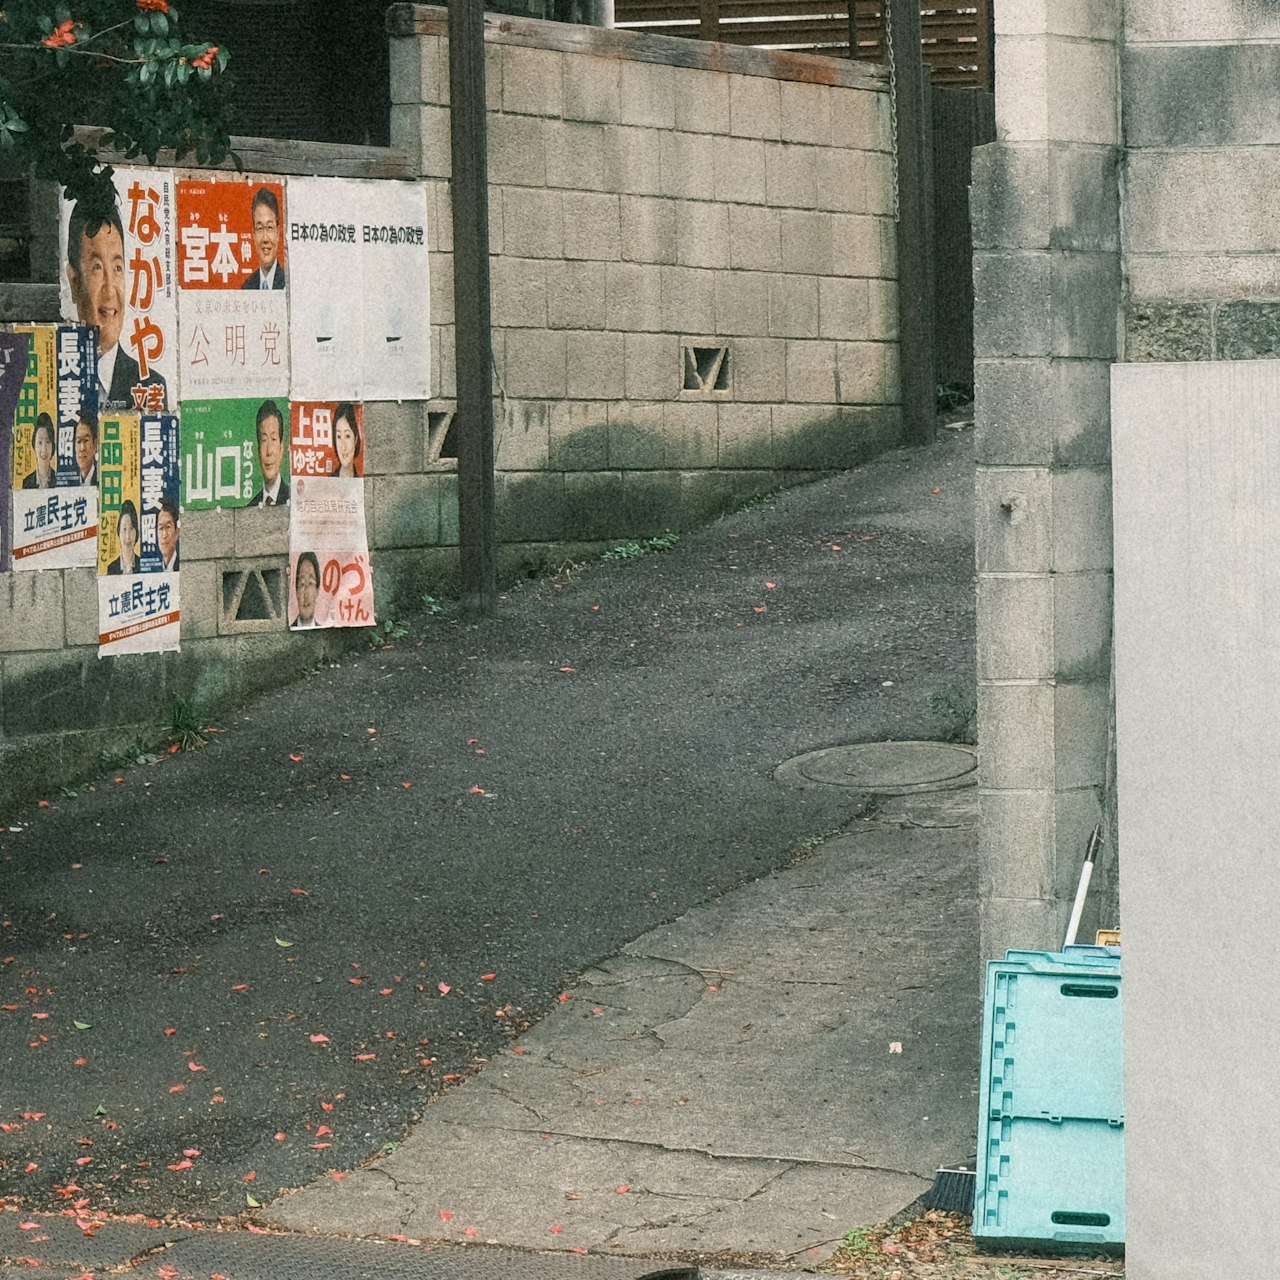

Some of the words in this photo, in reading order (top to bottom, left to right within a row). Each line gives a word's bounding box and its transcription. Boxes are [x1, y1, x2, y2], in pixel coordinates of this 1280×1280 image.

[181, 223, 239, 283] 宮本
[291, 222, 356, 243] 日本の為の政党
[362, 225, 424, 245] 日本の為の政党
[241, 241, 253, 275] 伸一
[127, 180, 165, 380] なかや
[190, 322, 281, 367] 公明党
[58, 332, 81, 458] 長妻昭
[131, 383, 165, 411] 文孝
[293, 406, 333, 448] 上田
[101, 421, 123, 513] 品田
[186, 443, 241, 504] 山口
[243, 440, 254, 499] なつお
[293, 449, 325, 474] ゆきこ
[141, 422, 164, 545] 長妻昭
[23, 495, 88, 532] 立憲民主党
[322, 555, 366, 596] のづ
[108, 581, 171, 618] 立憲民主党
[340, 599, 370, 622] けん
